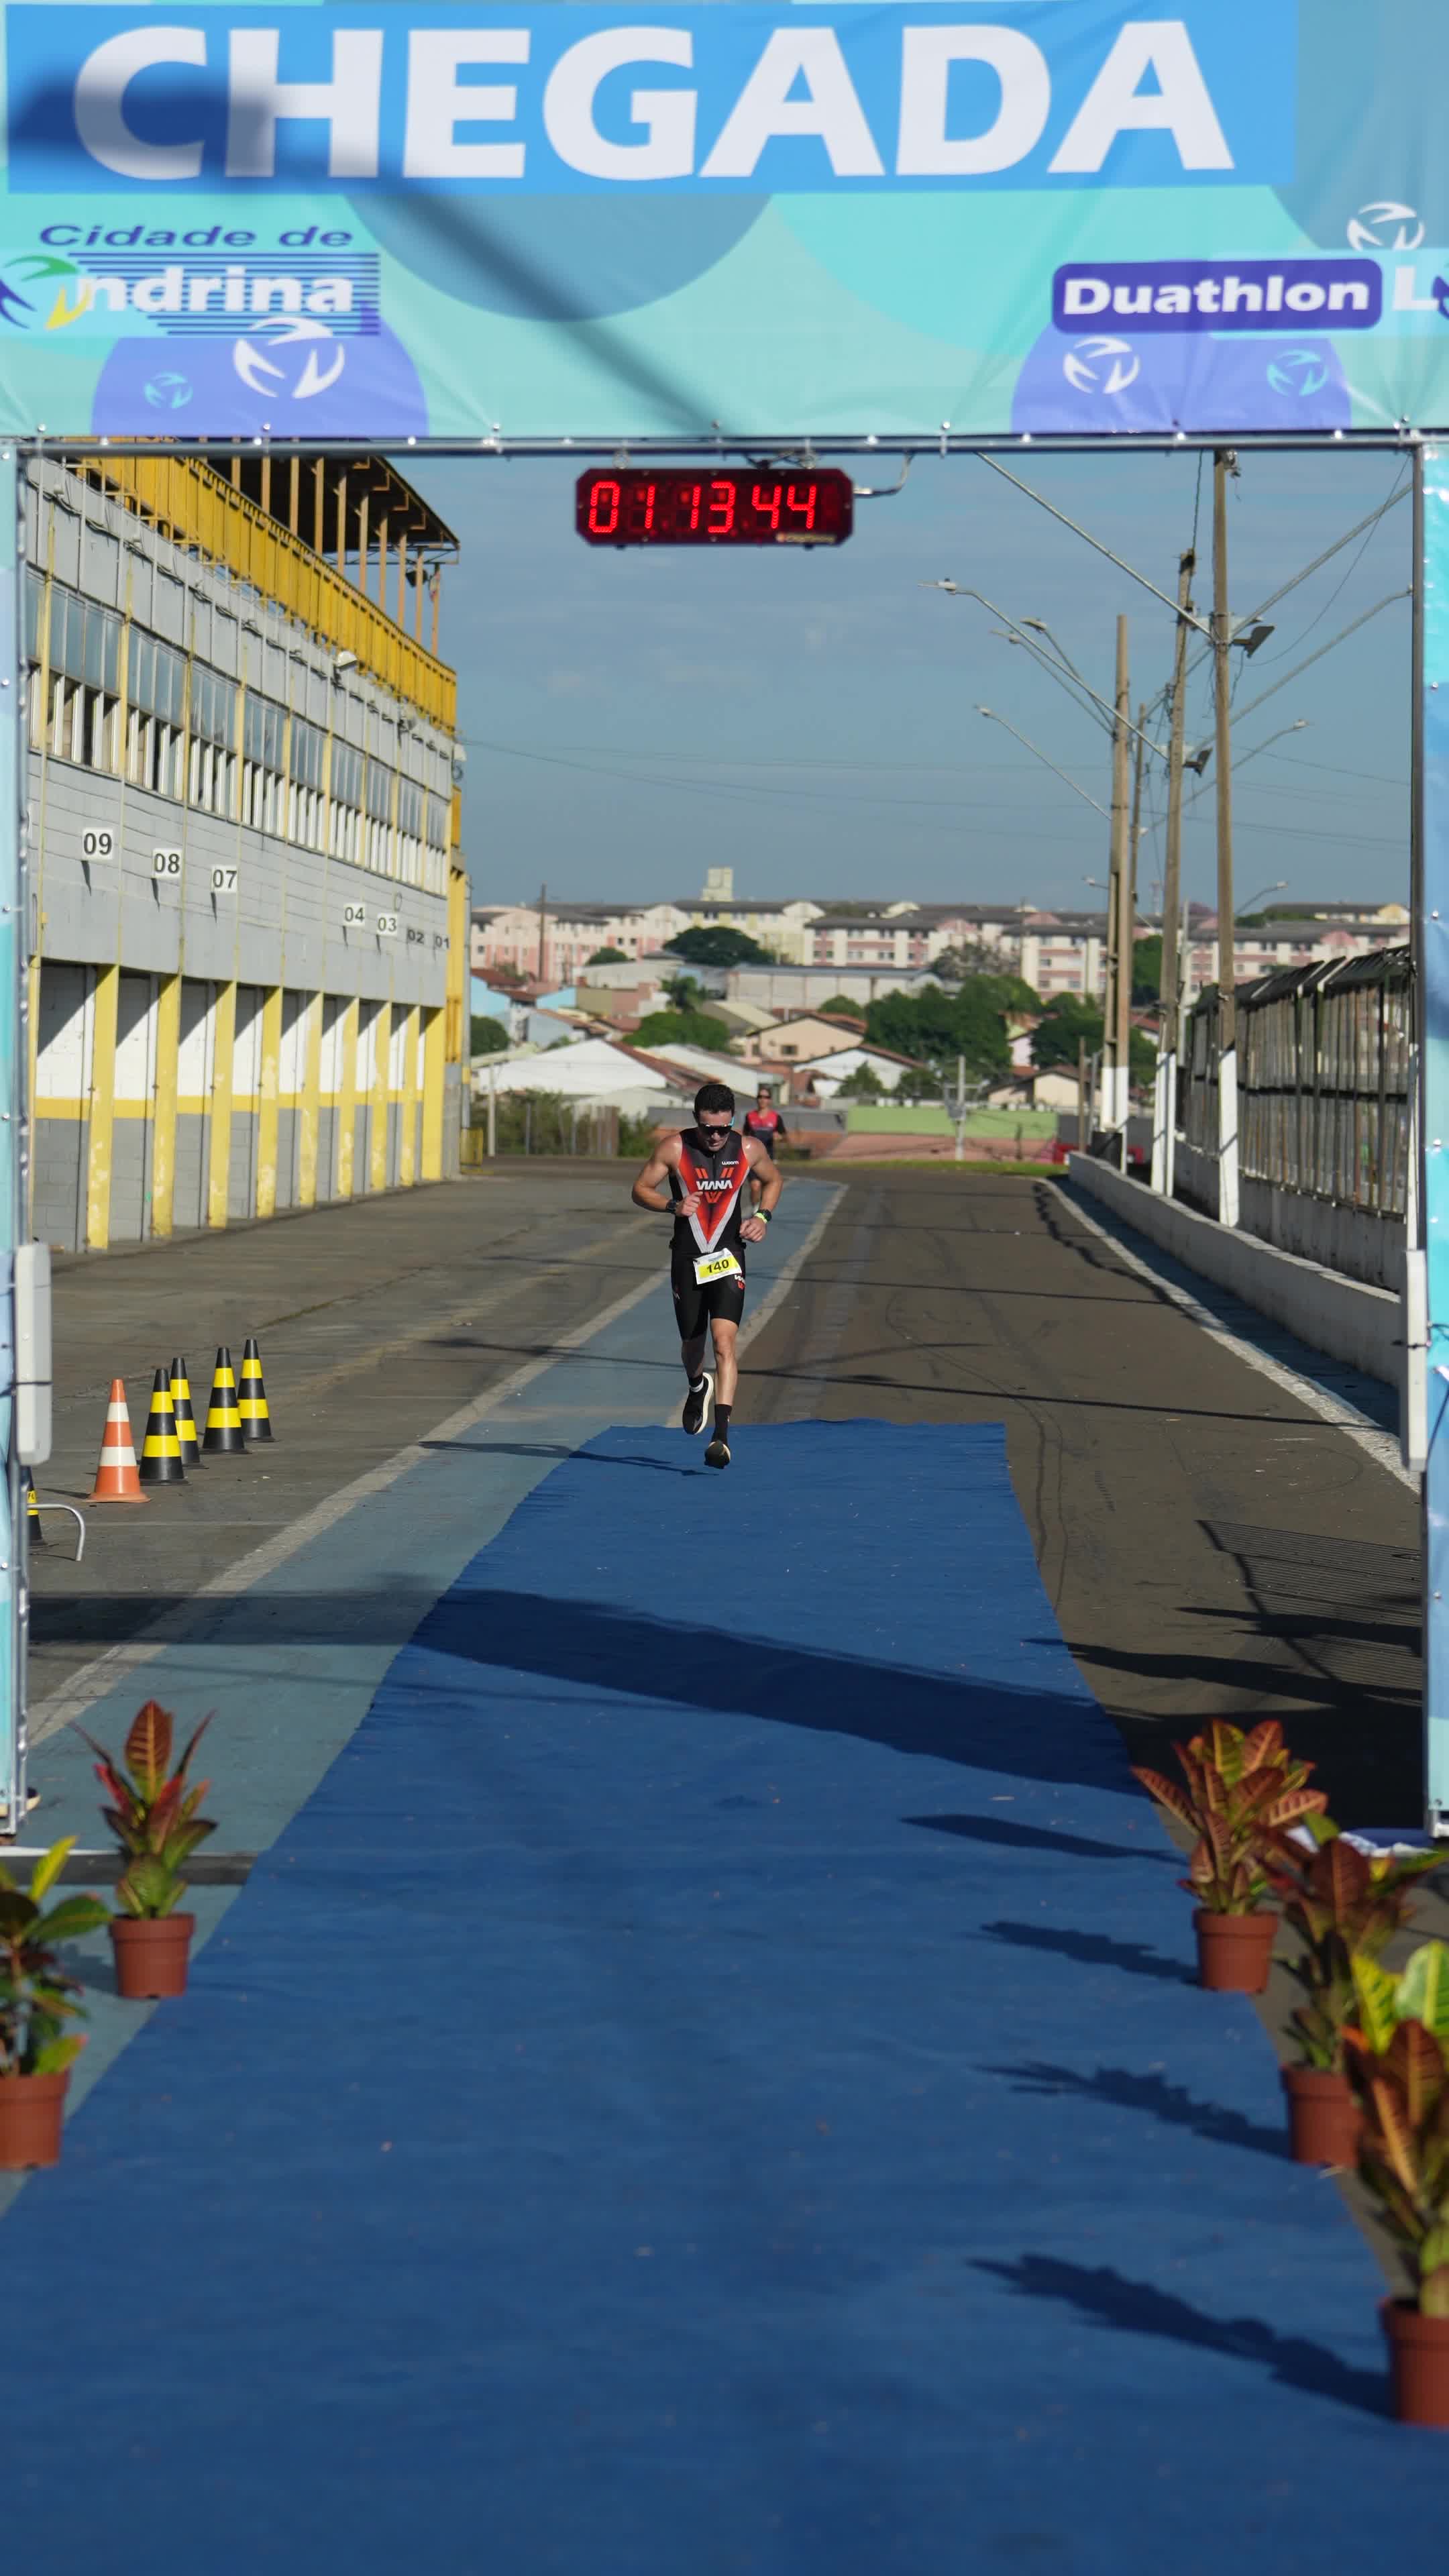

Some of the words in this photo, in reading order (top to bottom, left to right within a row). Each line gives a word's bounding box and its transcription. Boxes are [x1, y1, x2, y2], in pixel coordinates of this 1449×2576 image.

[74, 20, 1236, 181] CHEGADA
[40, 224, 257, 247] Cidade
[278, 226, 353, 247] de
[1063, 275, 1370, 315] Duathlon
[84, 833, 112, 855] 09
[154, 853, 180, 874] 08
[213, 869, 237, 888] 07
[345, 907, 364, 922] 04
[378, 917, 397, 932] 03
[407, 929, 425, 945] 02
[435, 935, 449, 949] 01
[696, 1179, 733, 1190] VIANA
[706, 1259, 730, 1273] 140
